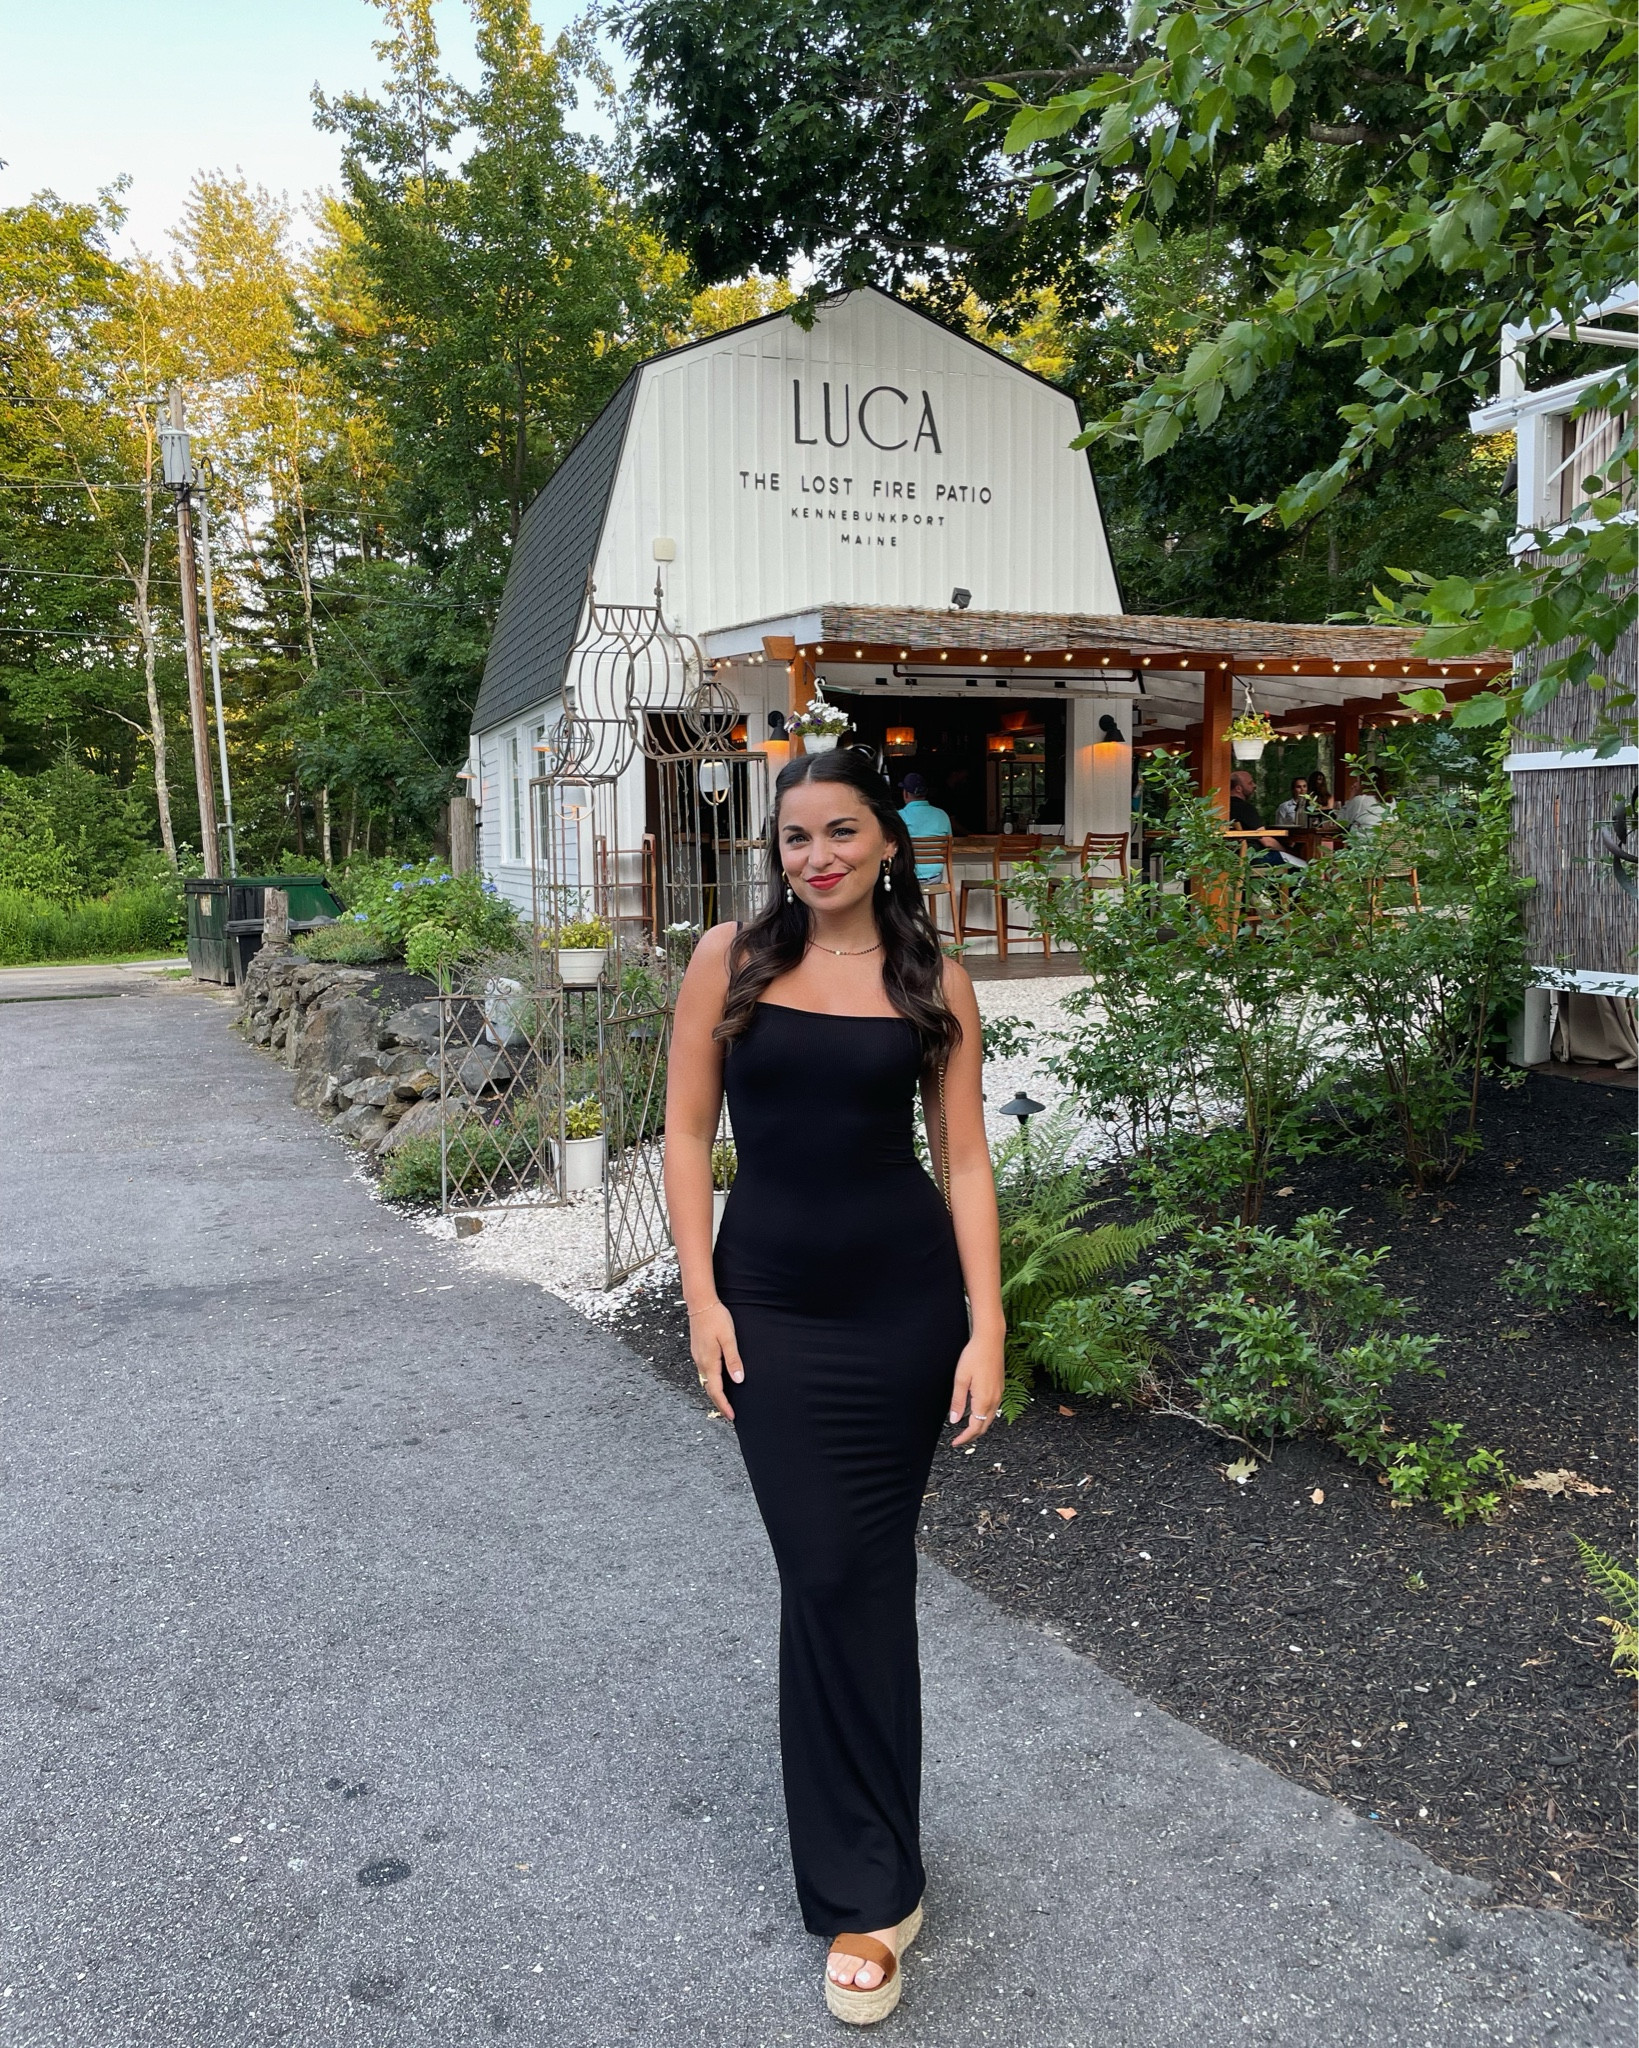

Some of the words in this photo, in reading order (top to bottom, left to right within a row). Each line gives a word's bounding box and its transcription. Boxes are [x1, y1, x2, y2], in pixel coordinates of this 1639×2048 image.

[793, 379, 942, 454] LUCA
[739, 471, 780, 491] THE
[801, 475, 853, 495] LOST
[873, 480, 916, 499] FIRE
[936, 484, 992, 504] PATIO
[791, 507, 945, 526] KENNEBUNKPORT
[841, 533, 897, 547] MAINE
